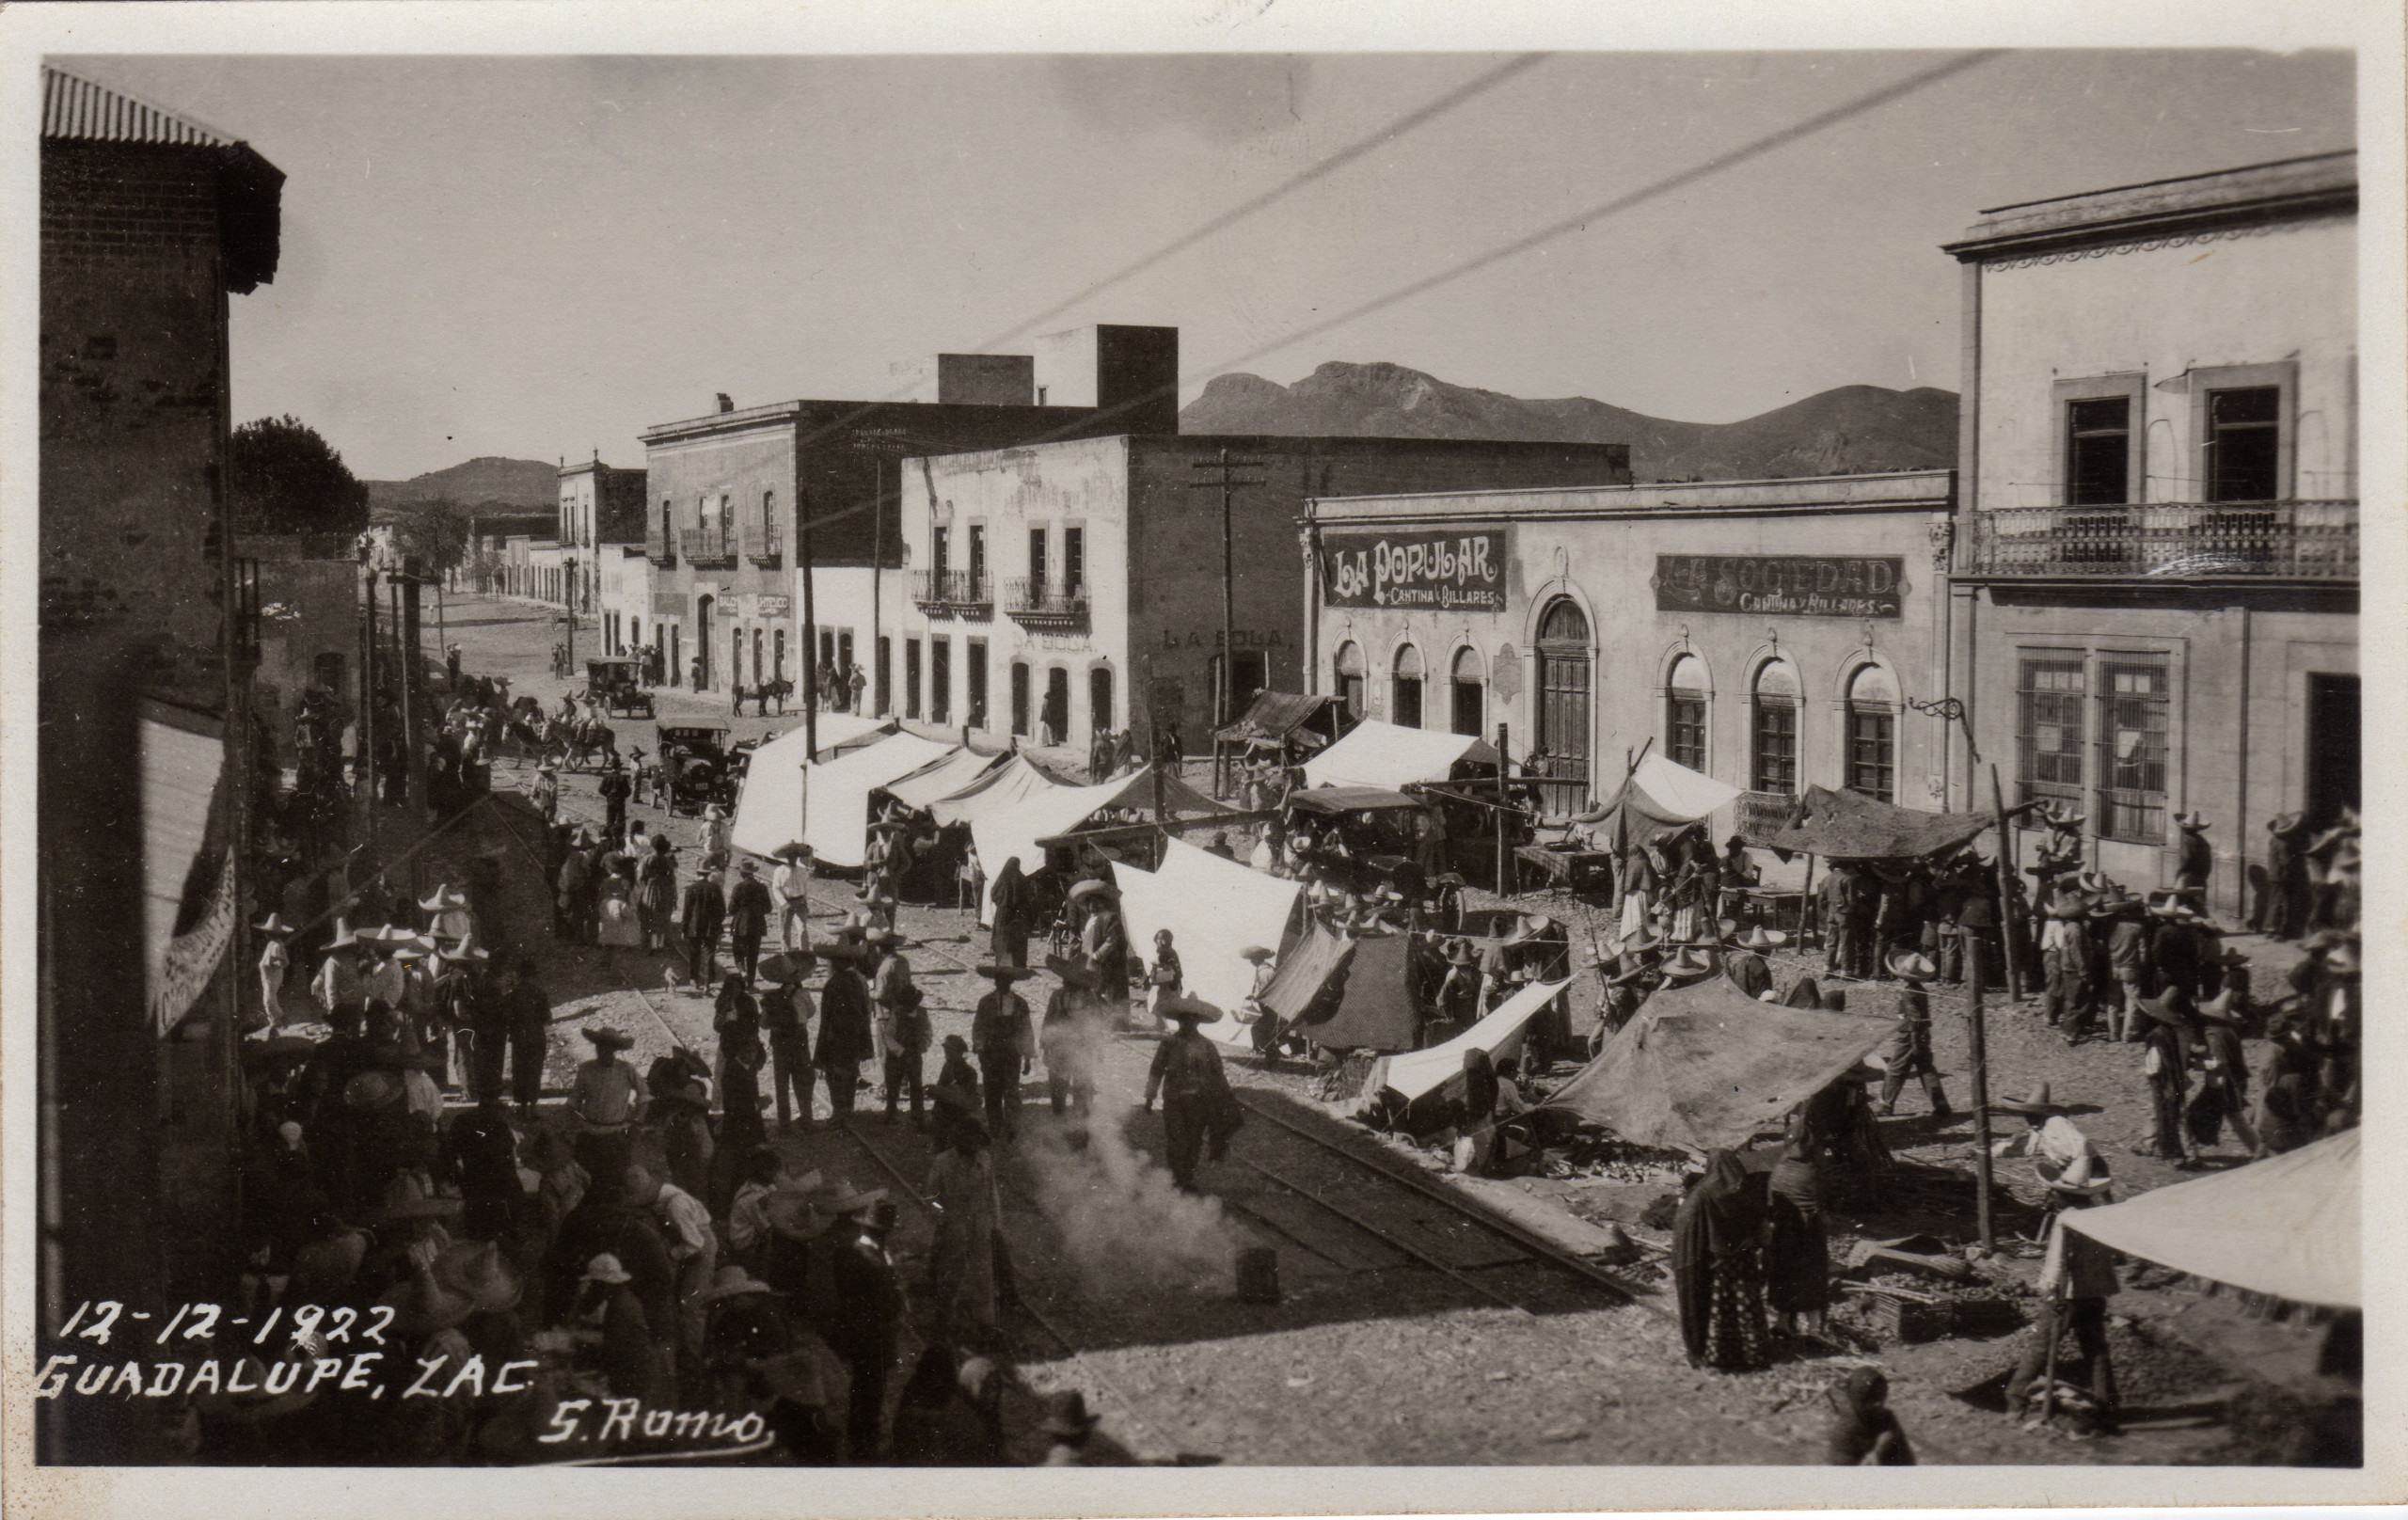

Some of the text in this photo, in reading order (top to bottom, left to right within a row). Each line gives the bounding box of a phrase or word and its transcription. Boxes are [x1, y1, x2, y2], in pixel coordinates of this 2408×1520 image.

[1334, 536, 1497, 605] LA POPULAR
[1659, 558, 1707, 607] LA
[1390, 587, 1434, 604] CANTINA
[1441, 585, 1495, 609] BILLARES
[1739, 589, 1796, 611] CANTINA
[1164, 629, 1203, 649] LA
